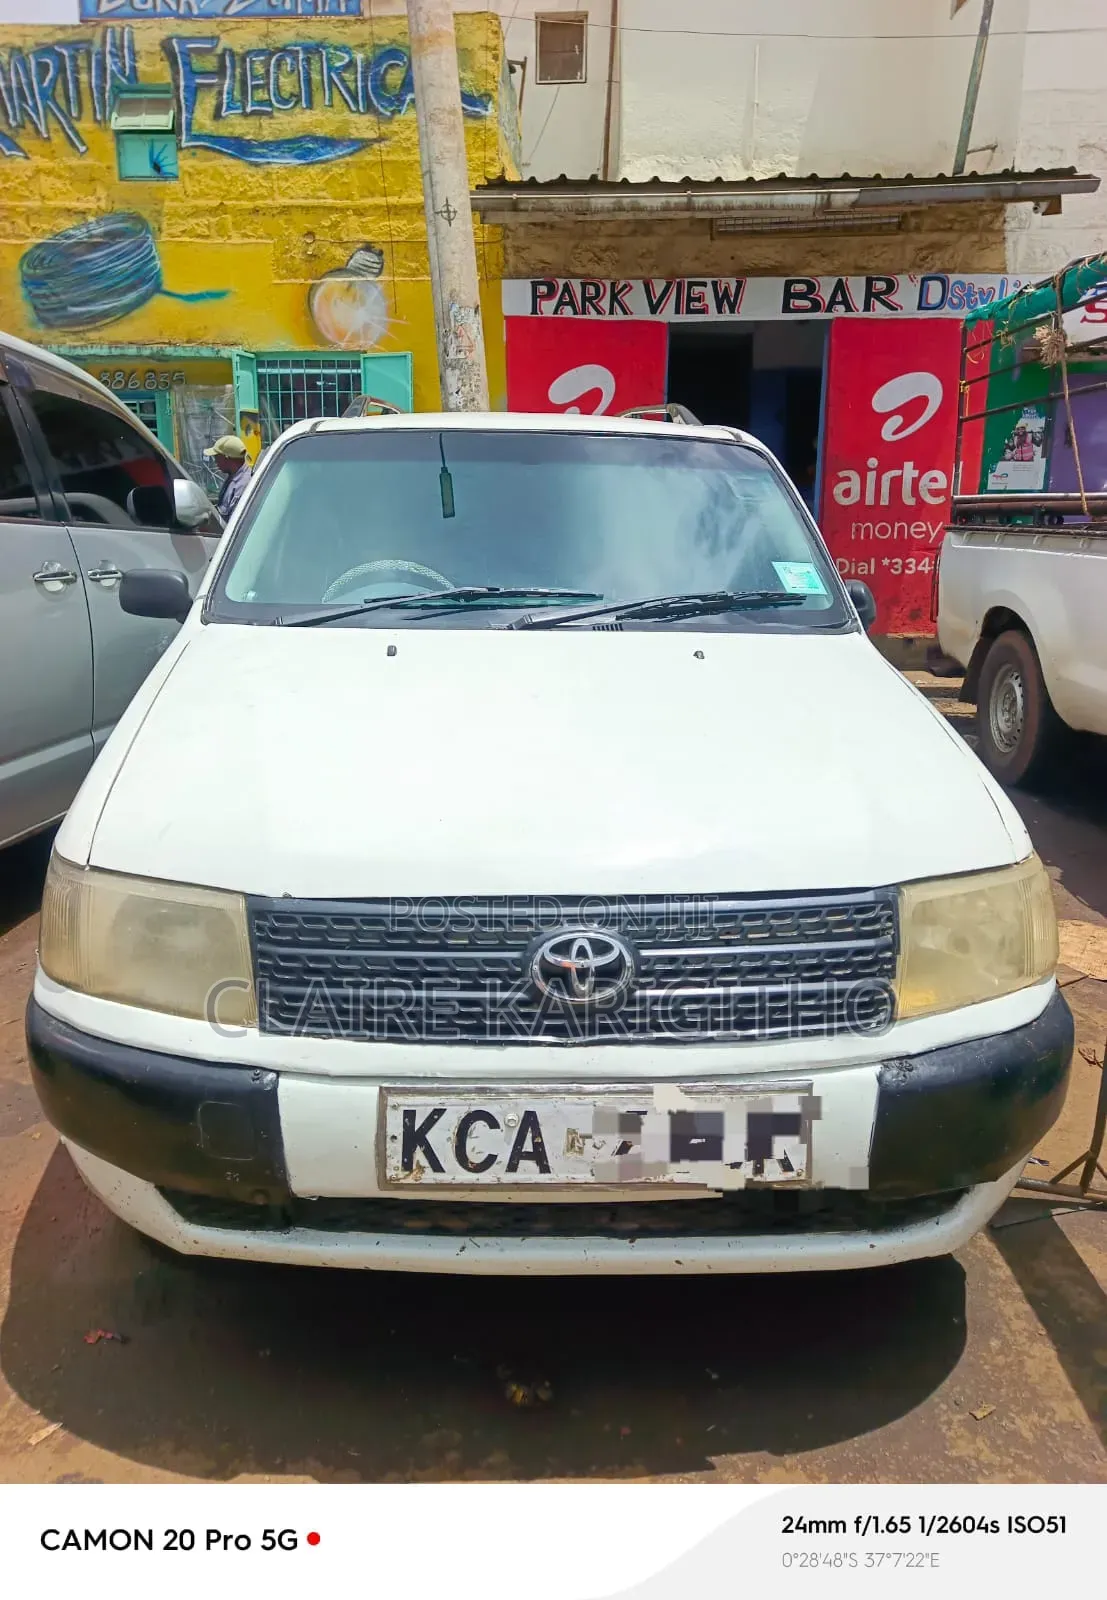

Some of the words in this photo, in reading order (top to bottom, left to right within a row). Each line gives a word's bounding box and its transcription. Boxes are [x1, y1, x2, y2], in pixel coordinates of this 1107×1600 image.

[530, 278, 633, 316] PARK
[643, 278, 747, 315] VIEW
[781, 275, 903, 314] BAR
[851, 521, 943, 544] money
[836, 557, 876, 575] Dial
[401, 1108, 551, 1174] KCA
